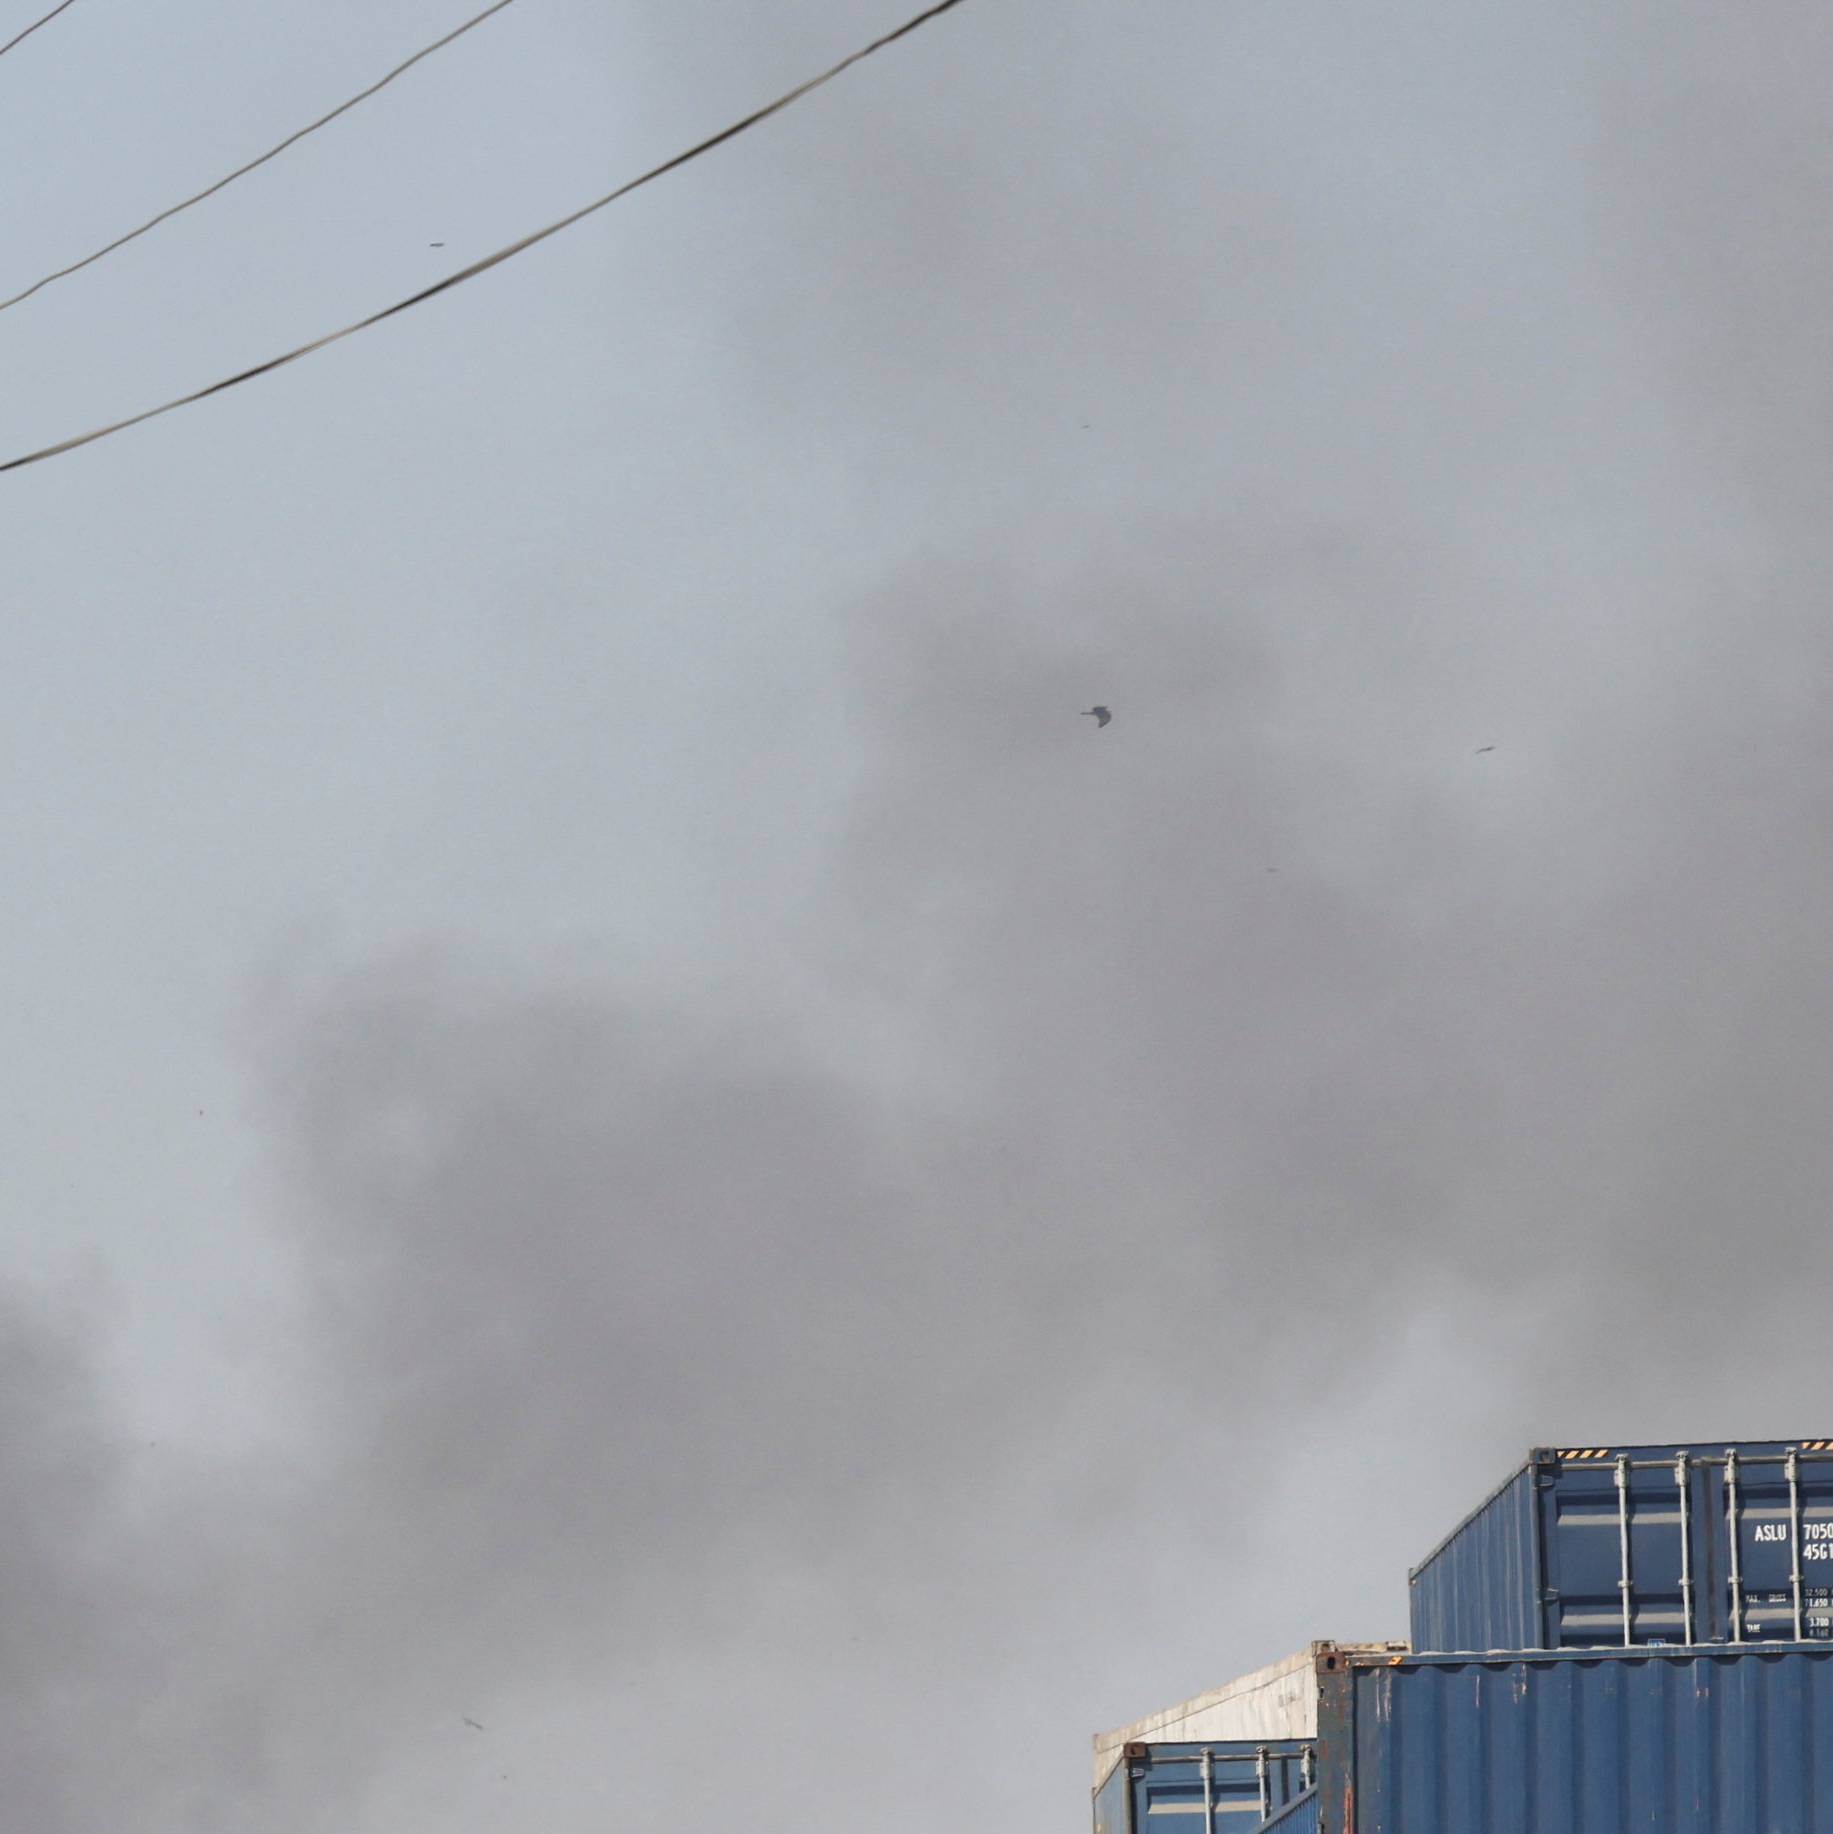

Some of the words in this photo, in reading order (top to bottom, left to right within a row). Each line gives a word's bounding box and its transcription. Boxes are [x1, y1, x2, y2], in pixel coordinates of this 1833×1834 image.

[1754, 1524, 1787, 1542] ASLU
[1803, 1523, 1833, 1541] 7050
[1803, 1543, 1833, 1561] 45G1
